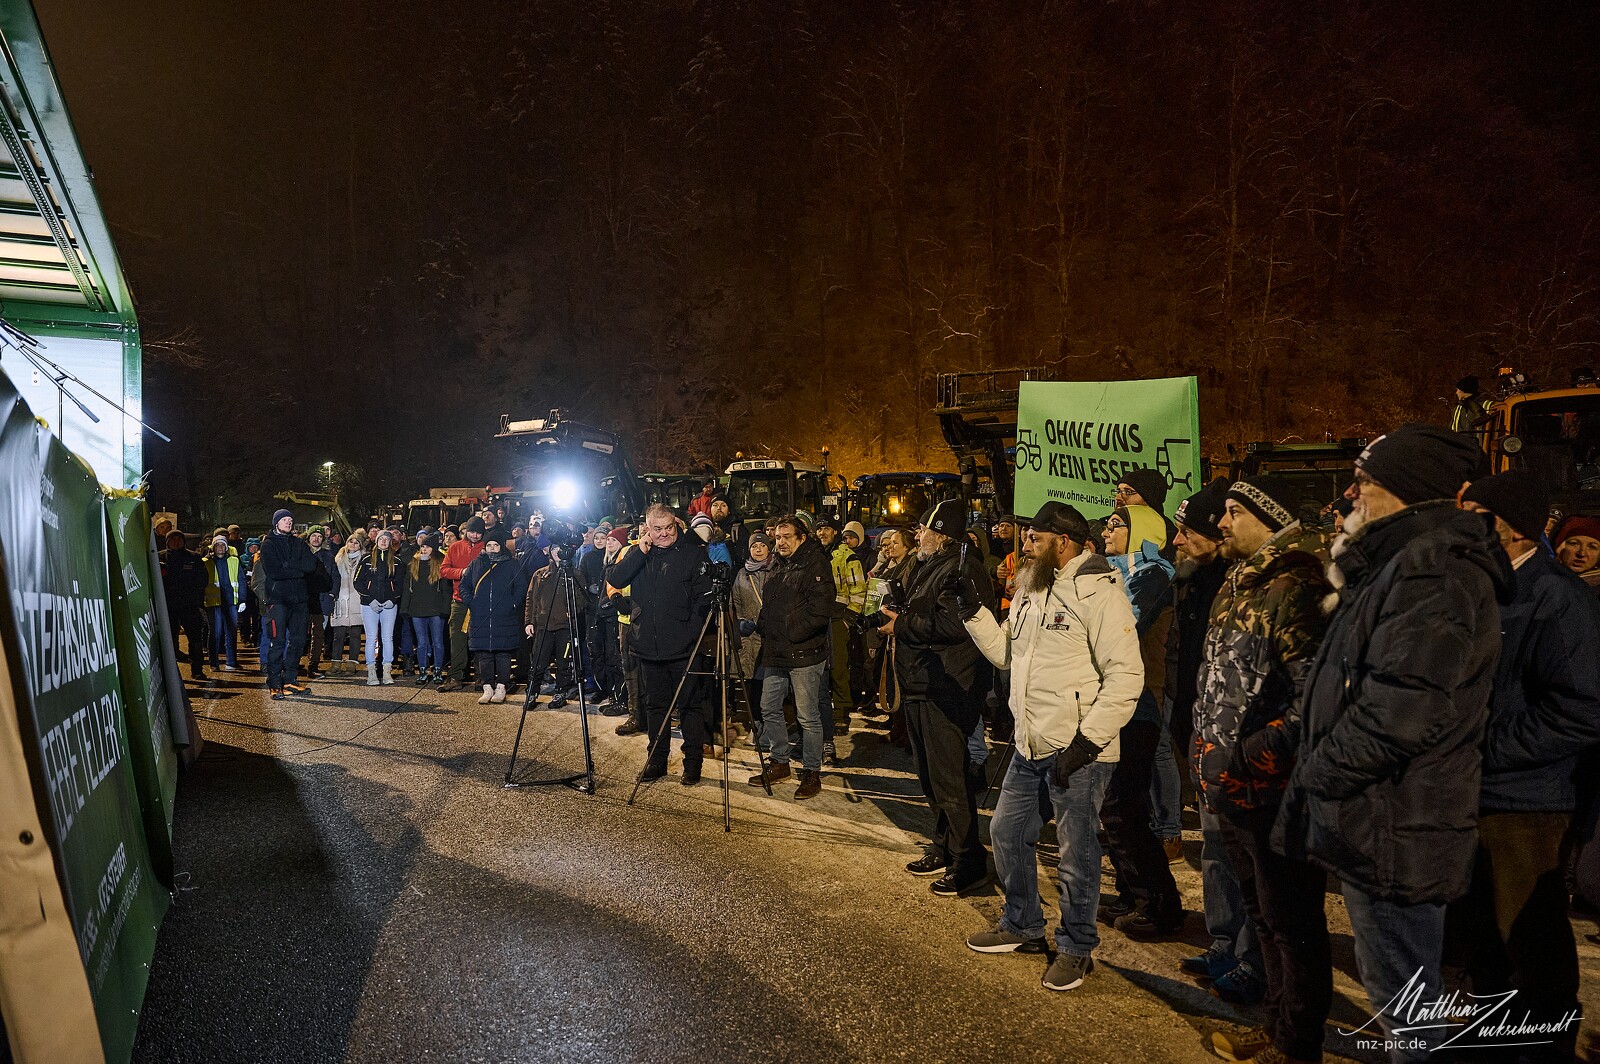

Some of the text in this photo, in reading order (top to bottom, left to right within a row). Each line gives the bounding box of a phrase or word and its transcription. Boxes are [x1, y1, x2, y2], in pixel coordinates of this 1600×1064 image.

[1044, 418, 1144, 453] OHNE UNS
[1048, 452, 1087, 481] KEIN
[1047, 488, 1116, 508] www.ohne-uns-kein
[41, 689, 126, 843] EERE TELLER?
